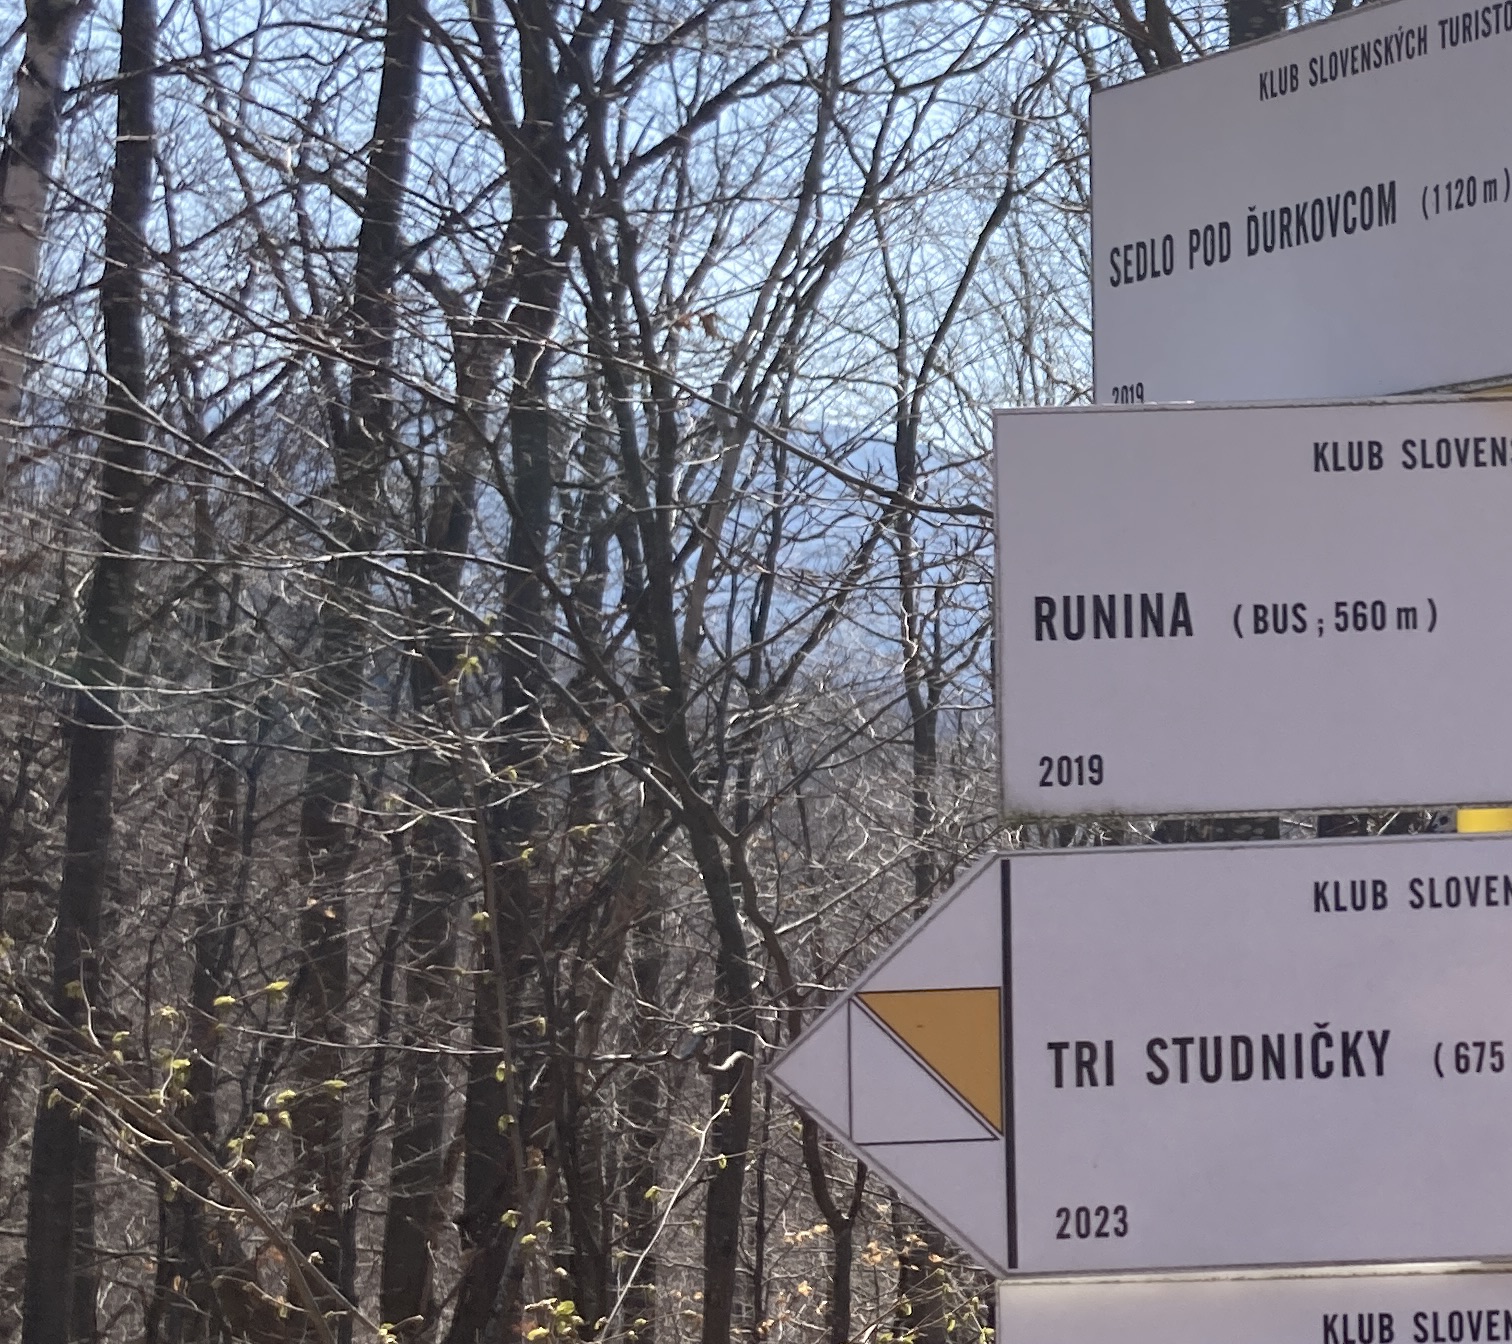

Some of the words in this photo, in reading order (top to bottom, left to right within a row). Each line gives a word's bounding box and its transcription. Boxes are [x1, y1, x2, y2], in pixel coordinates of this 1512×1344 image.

[1258, 64, 1299, 102] KLUB
[1308, 24, 1428, 88] SLOVENSKÝCH
[1109, 233, 1175, 288] SEDLO
[1188, 220, 1232, 271] POD
[1246, 179, 1397, 258] ĎURKOVCOM
[1312, 439, 1384, 473] KLUB
[1033, 591, 1194, 642] RUNINA
[1038, 753, 1104, 788] 2019
[1313, 878, 1389, 914] KLUB
[1046, 1039, 1115, 1089] TRI
[1145, 1021, 1392, 1086] STUDNIČKY
[1055, 1204, 1129, 1241] 2023
